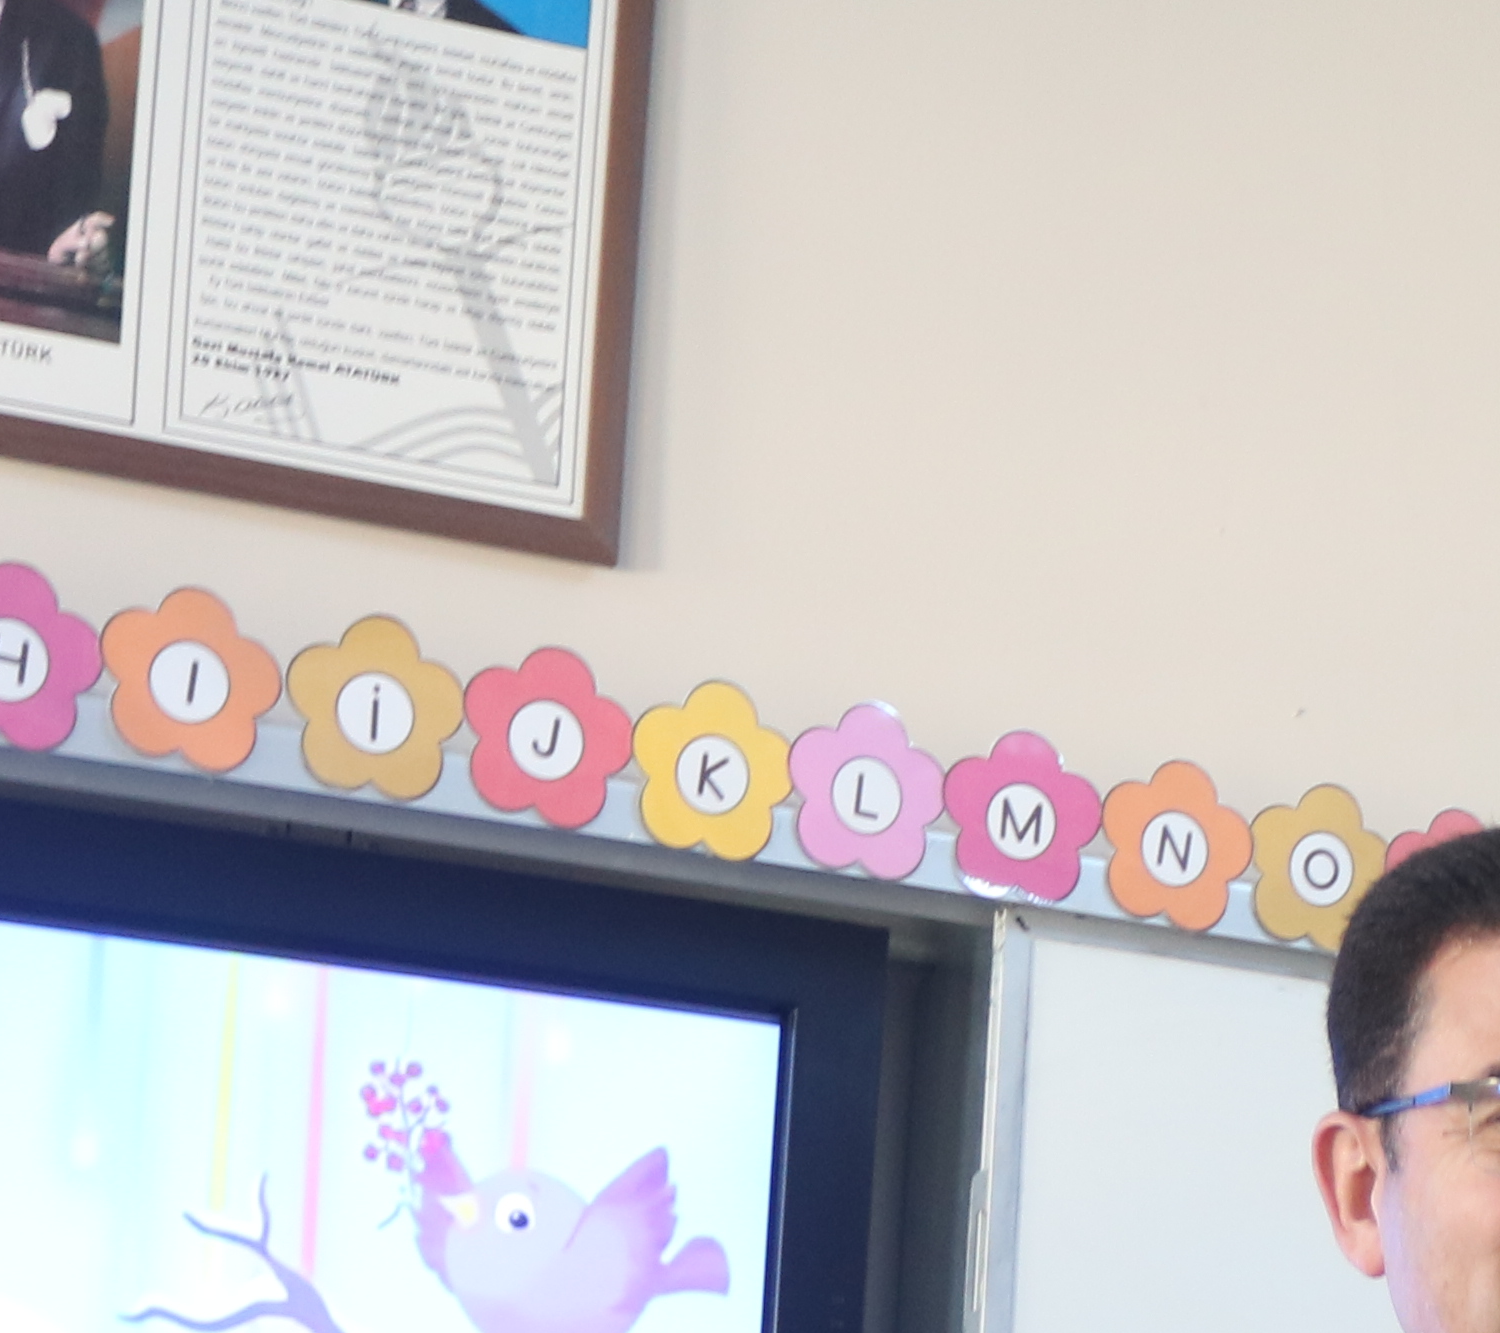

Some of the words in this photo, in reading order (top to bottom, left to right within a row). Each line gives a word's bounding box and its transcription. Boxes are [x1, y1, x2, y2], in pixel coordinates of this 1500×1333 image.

[370, 685, 381, 742] İ
[531, 717, 561, 759] J
[697, 752, 730, 801] K
[853, 773, 878, 820] L
[1000, 797, 1043, 845] M
[1156, 824, 1193, 872] N
[1303, 848, 1340, 891] O
